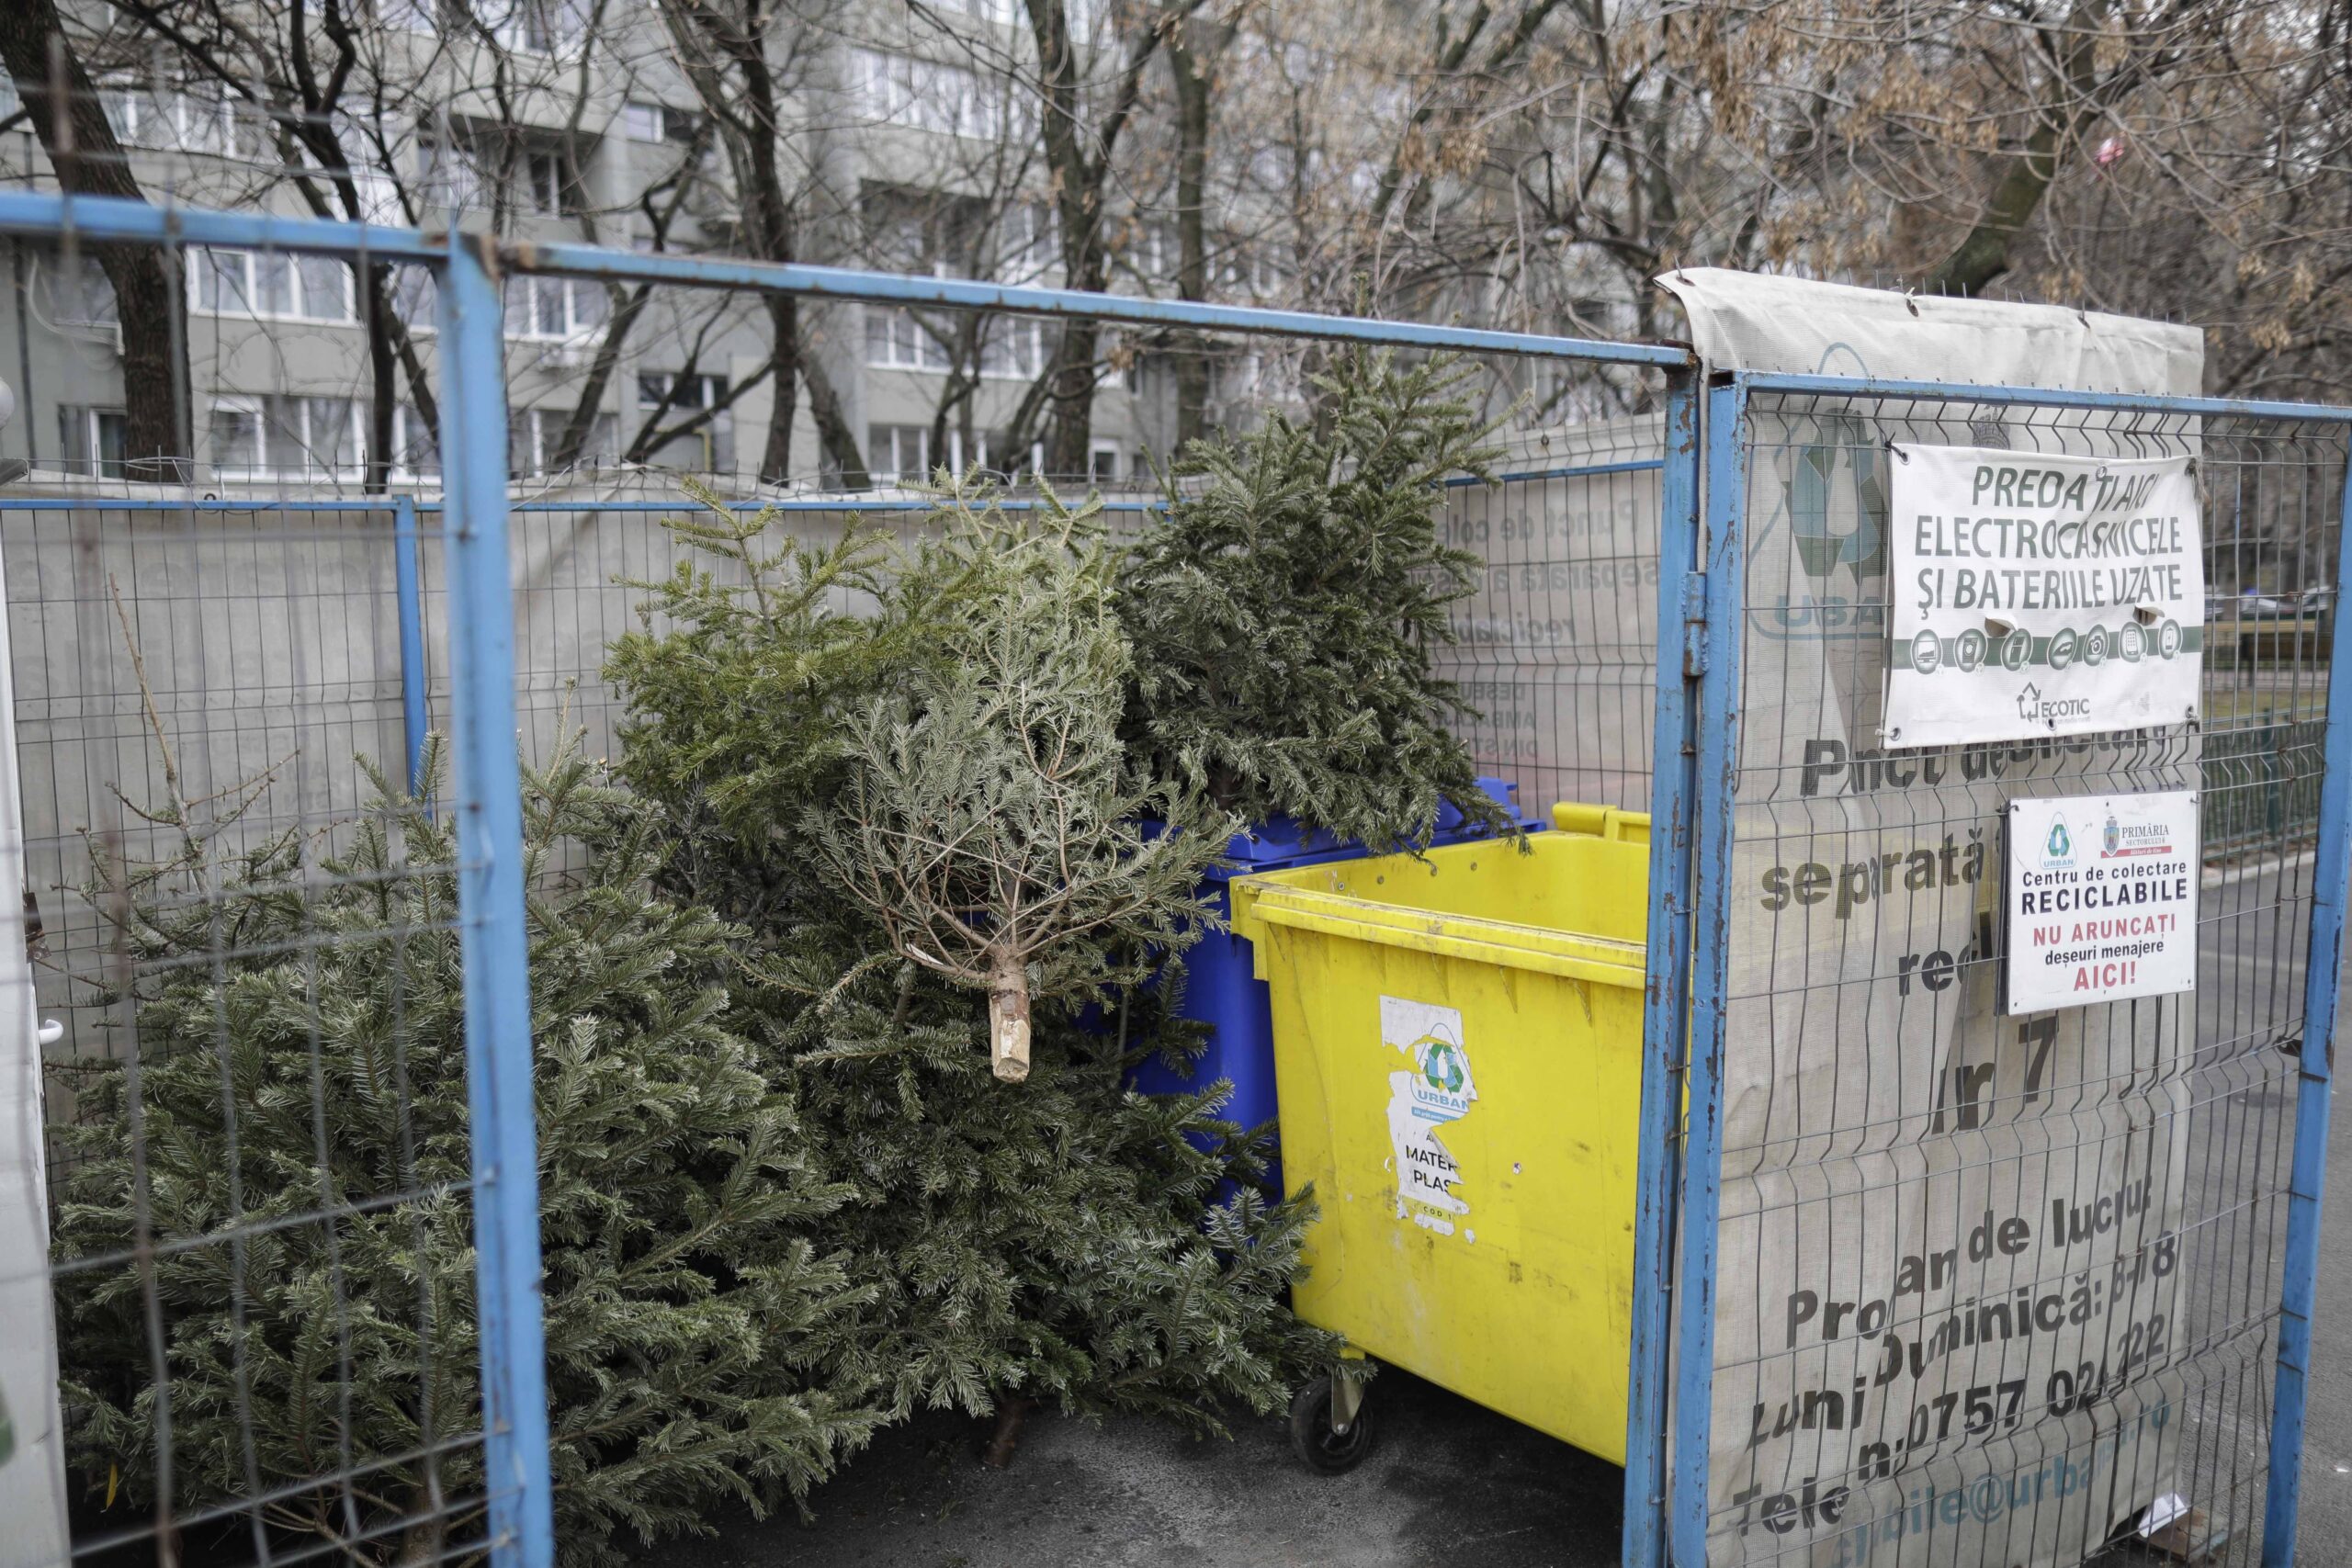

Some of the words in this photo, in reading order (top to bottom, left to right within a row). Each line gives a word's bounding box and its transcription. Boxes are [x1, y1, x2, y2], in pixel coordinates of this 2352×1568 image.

[1915, 515, 2183, 559] ELECTROCASNICELE
[1953, 569, 2105, 609] BATERIILE
[2109, 564, 2182, 605] UZATE
[2041, 698, 2090, 717] ECOTIC
[2023, 869, 2077, 886] Centru
[2086, 867, 2104, 882] de
[2112, 862, 2187, 879] colectare
[2043, 858, 2074, 868] URBAN
[2022, 878, 2187, 915] RECICLABILE
[2033, 925, 2061, 946] NU
[2071, 914, 2176, 942] ARUNCAȚI
[2045, 945, 2097, 967] deșeuri
[2101, 940, 2164, 959] menajere
[2074, 961, 2136, 992] AICI!
[1423, 1205, 1442, 1218] COD
[1968, 1210, 2030, 1263] de
[1909, 1378, 2027, 1450] 0757
